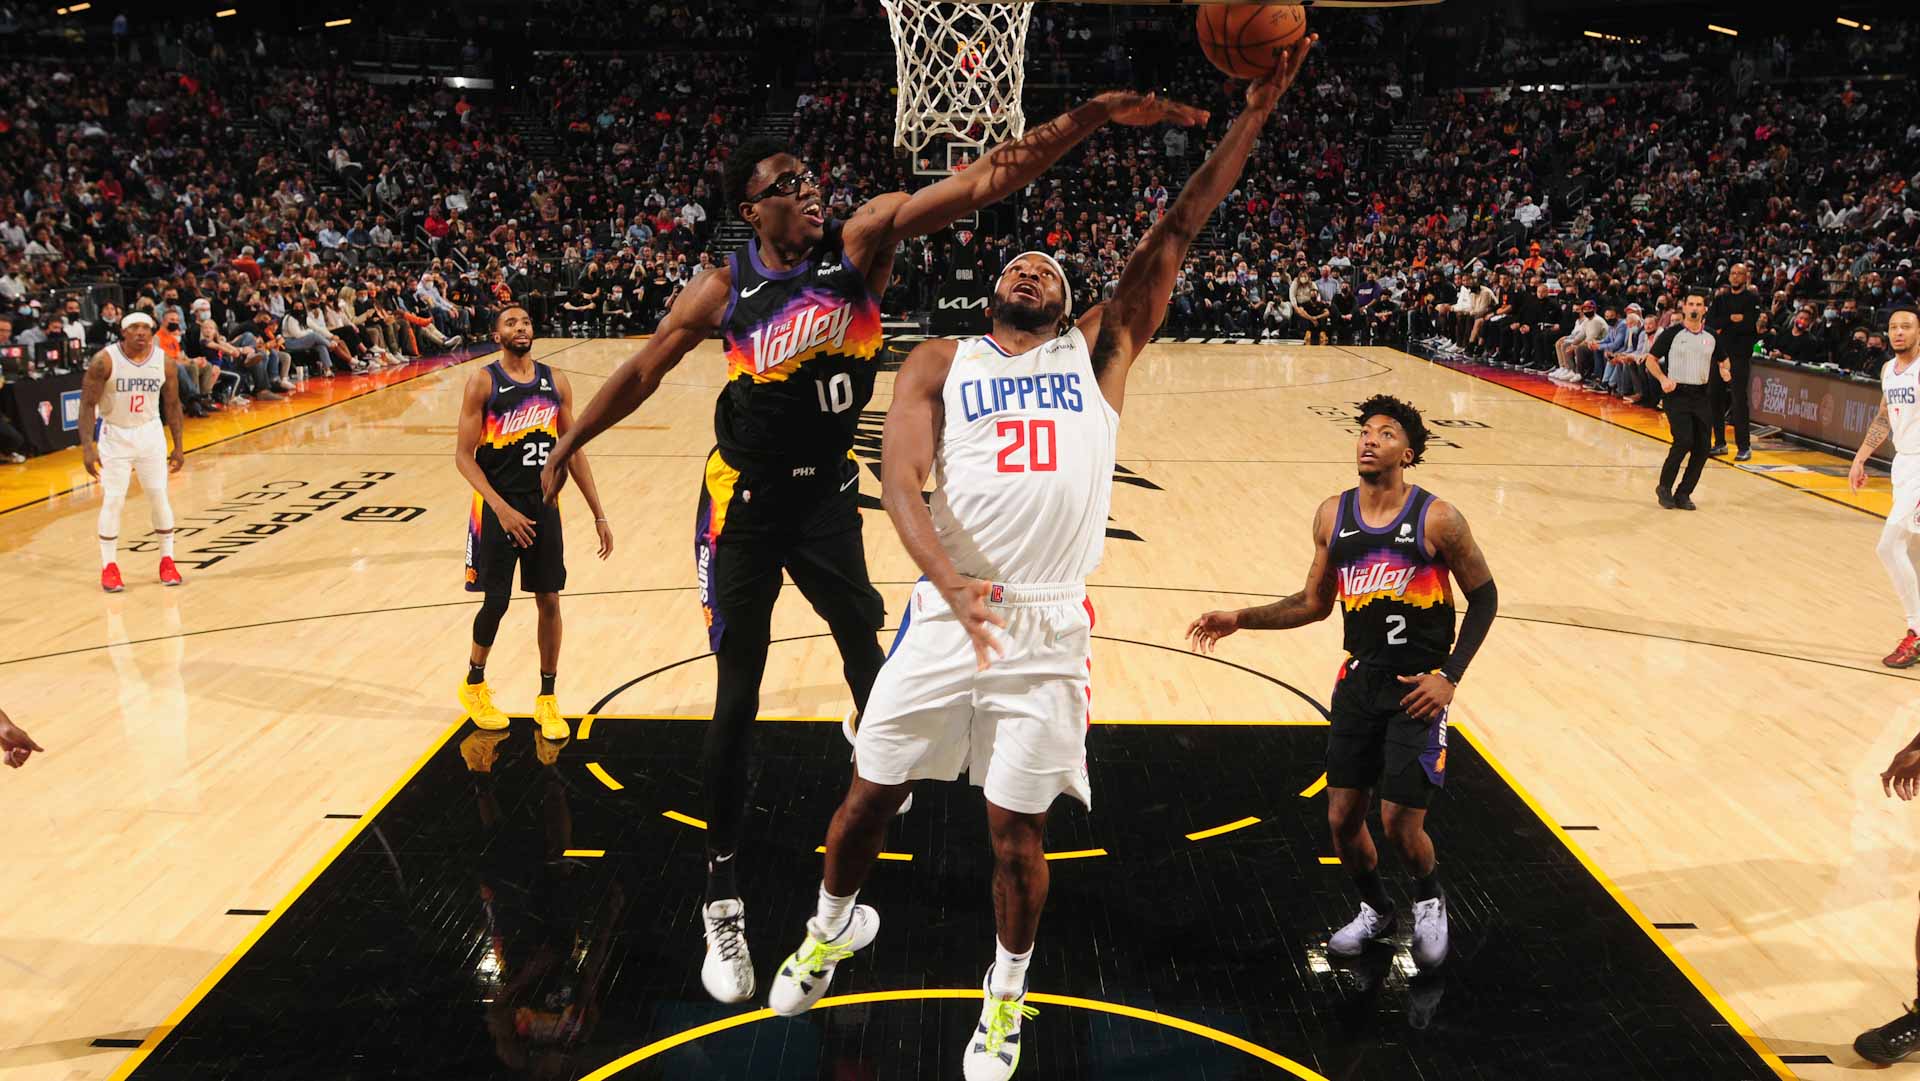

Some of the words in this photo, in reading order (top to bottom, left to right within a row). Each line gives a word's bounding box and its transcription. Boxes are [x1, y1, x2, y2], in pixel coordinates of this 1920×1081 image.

[817, 264, 842, 276] PayPal
[750, 302, 853, 374] Valley
[774, 320, 793, 335] THE
[116, 378, 160, 392] CLIPPERS
[815, 372, 853, 414] 10
[960, 372, 1083, 422] CLIPPERS
[129, 395, 145, 413] 12
[501, 404, 556, 435] Valley
[522, 442, 550, 466] 25
[996, 420, 1057, 472] 20
[793, 467, 816, 477] PHX
[116, 480, 309, 552] CENTER
[174, 471, 396, 569] FOOTPRINT
[698, 545, 710, 603] SUNS
[1341, 562, 1416, 596] Valley
[1356, 567, 1369, 575] THE
[1385, 614, 1407, 645] 2
